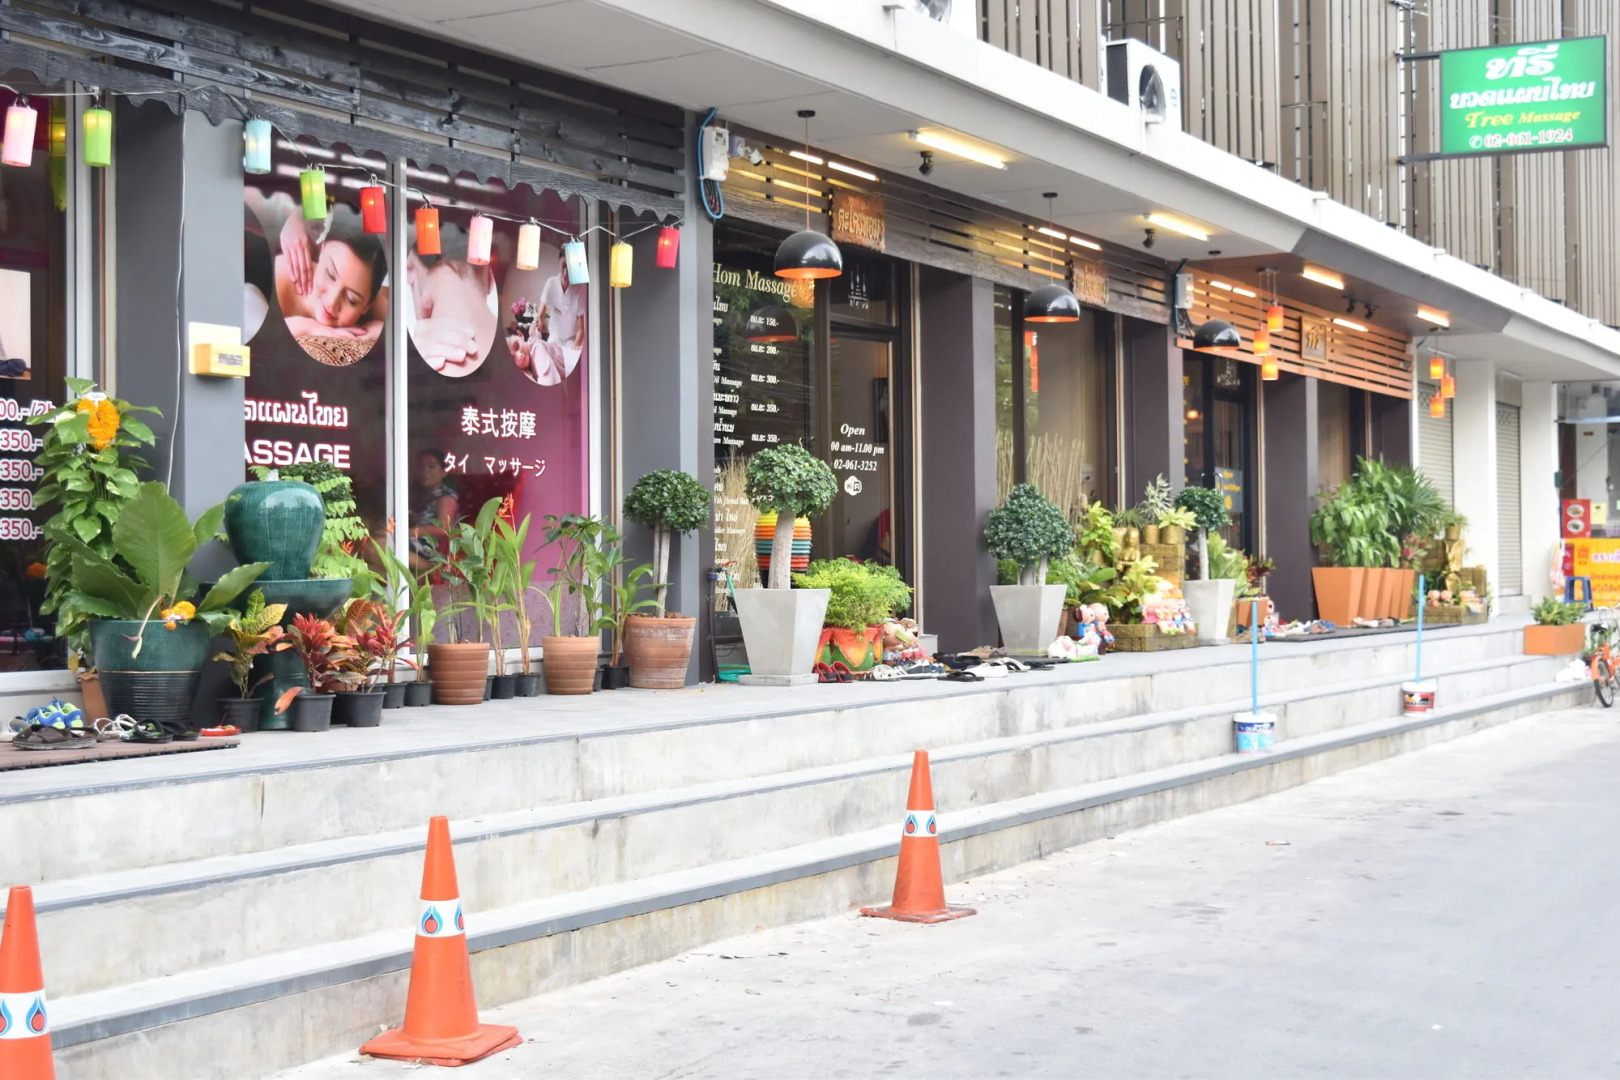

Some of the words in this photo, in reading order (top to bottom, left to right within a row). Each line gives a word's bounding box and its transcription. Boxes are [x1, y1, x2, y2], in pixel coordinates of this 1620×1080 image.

[1450, 76, 1596, 109] นวดแผนไทย
[1464, 111, 1514, 128] Tree
[1517, 110, 1581, 123] Massage
[1484, 127, 1573, 148] 02-061-1924
[745, 269, 797, 303] Massage
[461, 405, 536, 439] 泰式按摩
[840, 423, 865, 437] Open
[0, 430, 43, 451] 350.-
[873, 446, 885, 456] pm
[0, 460, 44, 481] 350.-
[444, 453, 469, 473] タイ
[484, 456, 546, 477] マッサージ
[833, 458, 878, 471] 02-061-3252
[0, 489, 36, 510] 350
